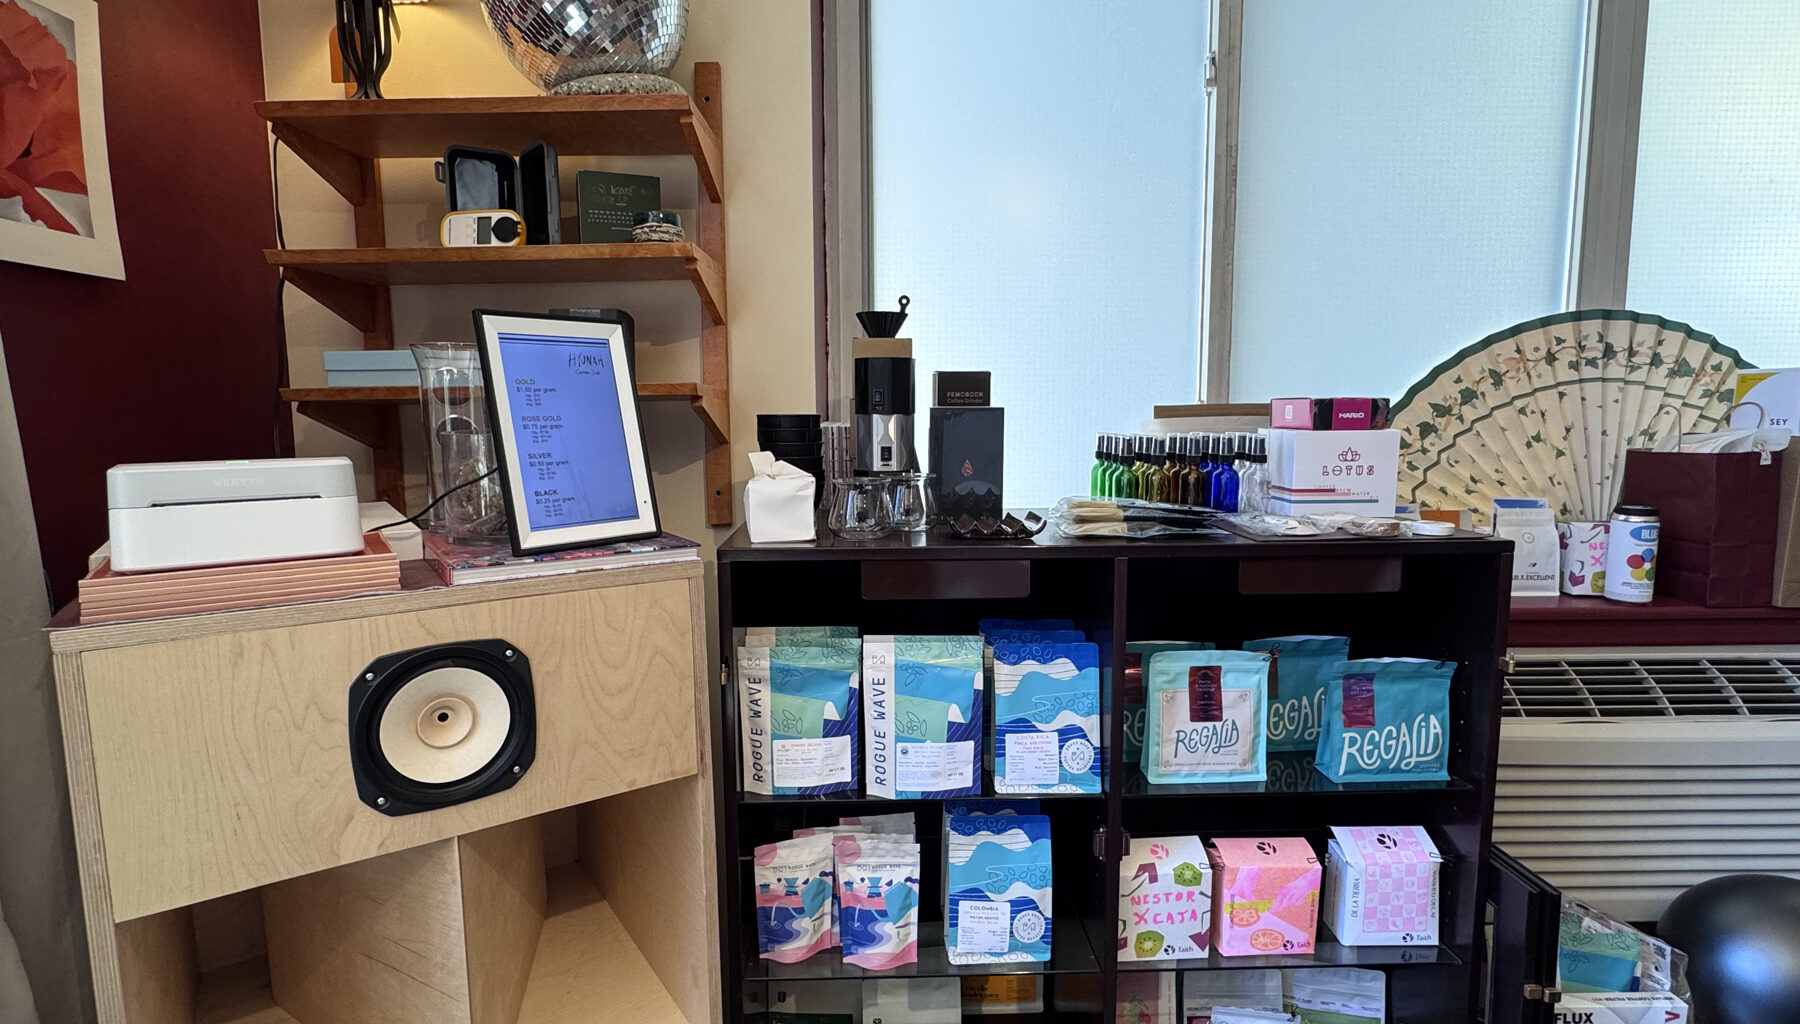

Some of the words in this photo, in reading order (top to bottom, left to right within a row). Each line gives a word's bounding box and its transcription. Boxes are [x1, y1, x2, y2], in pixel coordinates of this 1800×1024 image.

[1322, 465, 1374, 476] LOTUS
[1642, 529, 1658, 539] BLUE
[748, 677, 762, 719] WAVE
[872, 678, 886, 720] WAVE
[751, 727, 764, 783] ROGUE
[874, 730, 886, 786] ROGUE
[1130, 891, 1195, 906] NESTOR
